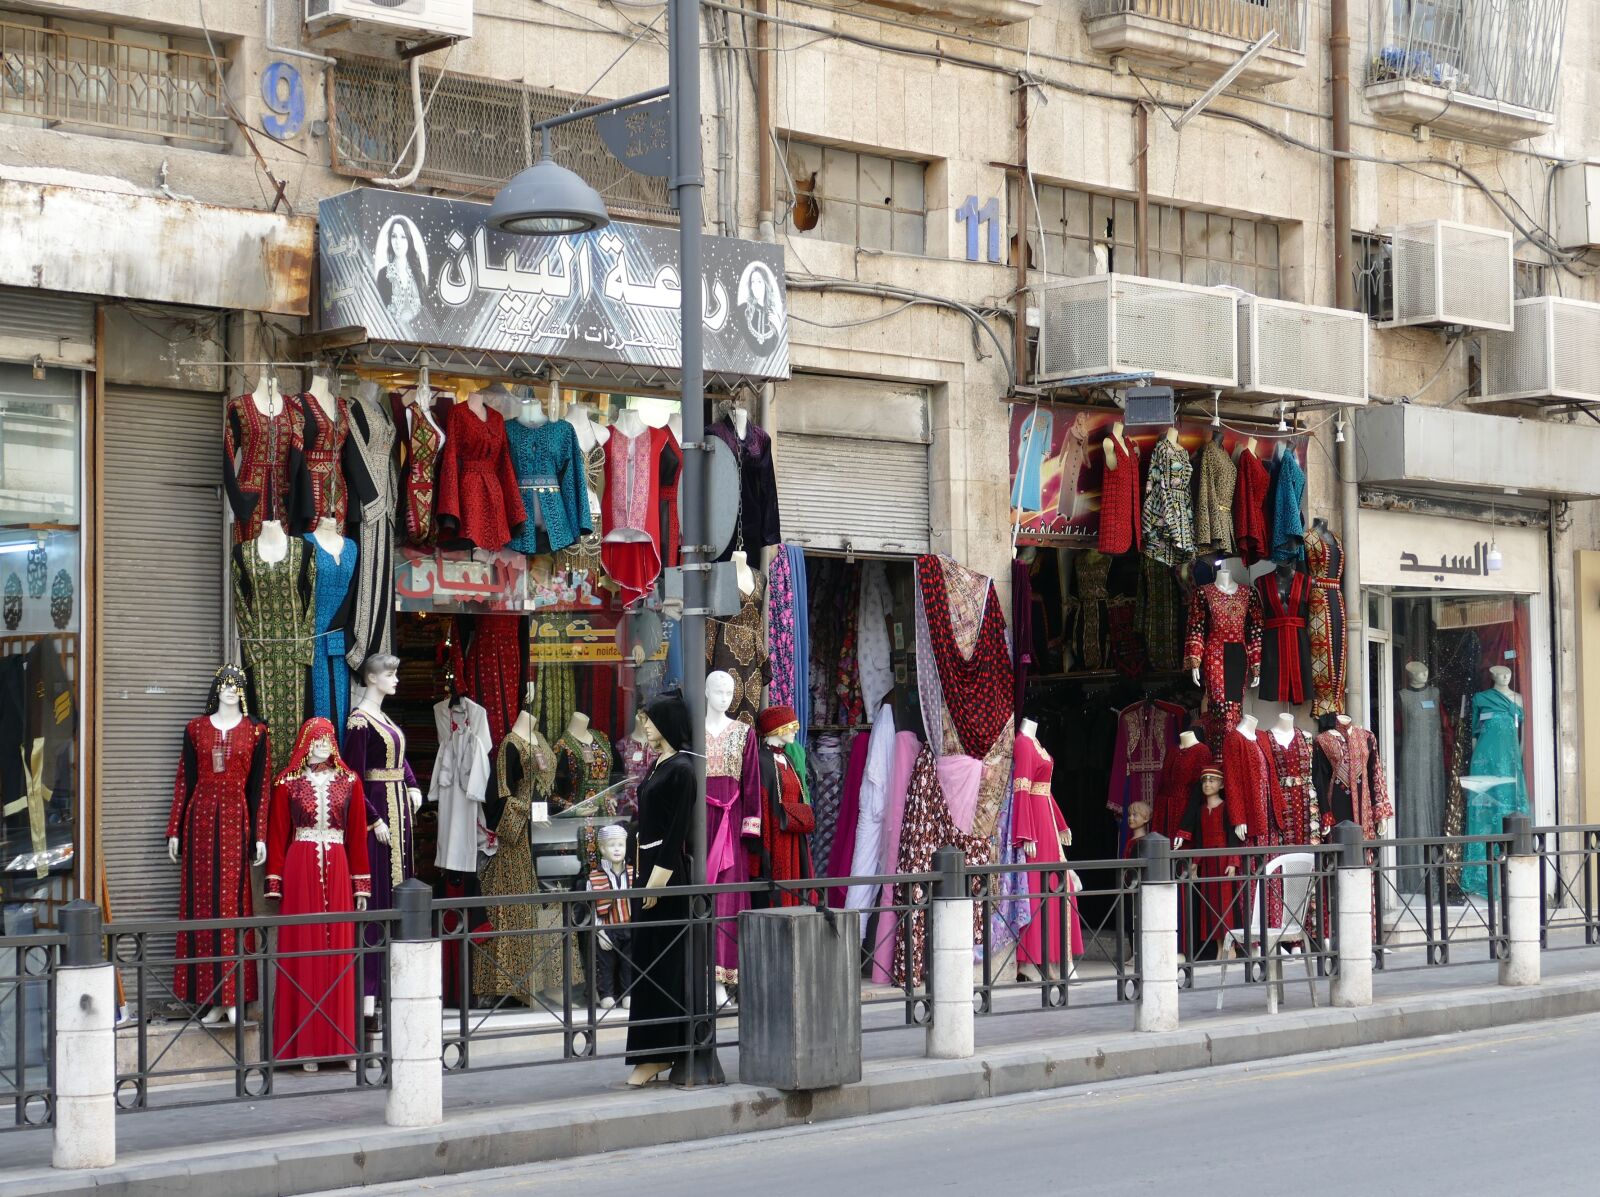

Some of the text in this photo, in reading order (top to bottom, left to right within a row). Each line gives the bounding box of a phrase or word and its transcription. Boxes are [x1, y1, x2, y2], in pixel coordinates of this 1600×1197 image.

[261, 61, 305, 140] 9
[955, 195, 1000, 263] 11
[439, 225, 729, 331] رعة البيان
[397, 554, 519, 603] البيان
[1400, 541, 1489, 582] السيد
